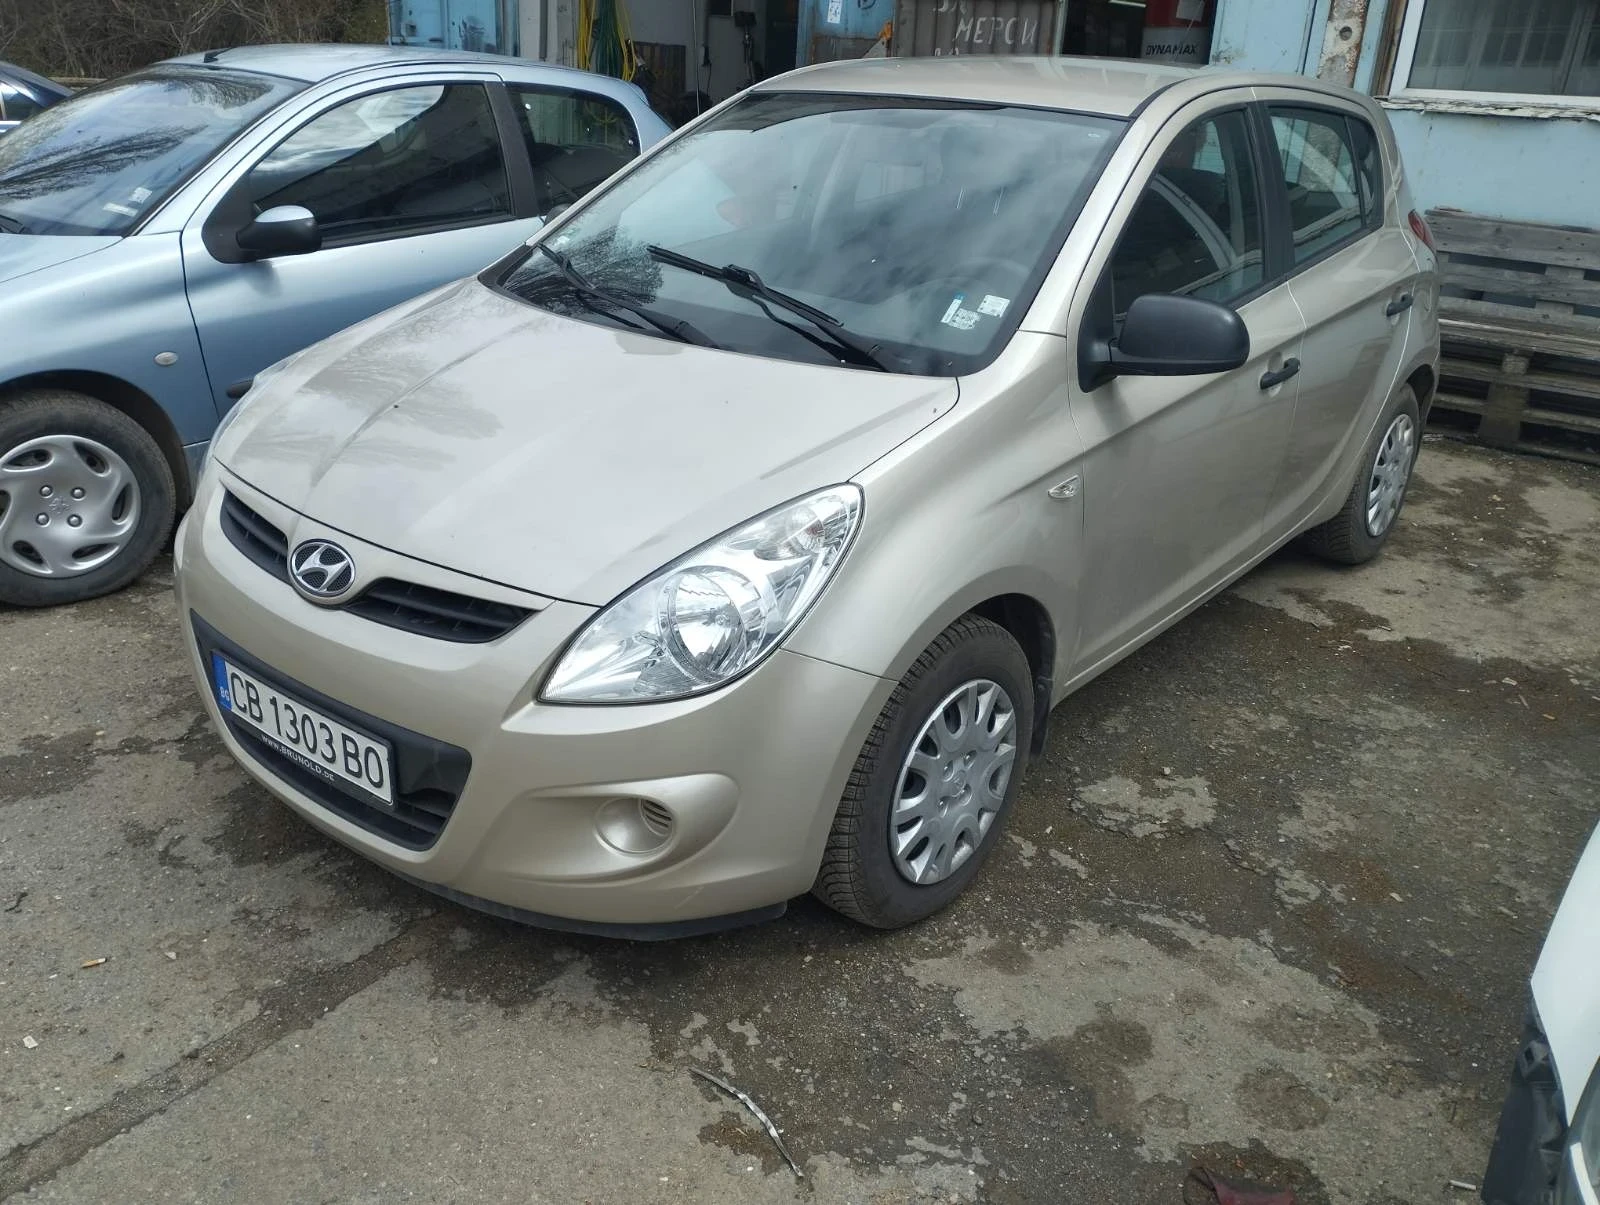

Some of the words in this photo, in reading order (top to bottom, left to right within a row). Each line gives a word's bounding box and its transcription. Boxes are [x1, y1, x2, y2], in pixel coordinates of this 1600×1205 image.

[952, 17, 1038, 45] МЕРСИ
[1145, 44, 1197, 56] DYNAMAX
[231, 673, 264, 724] CB
[269, 695, 337, 764] 1303
